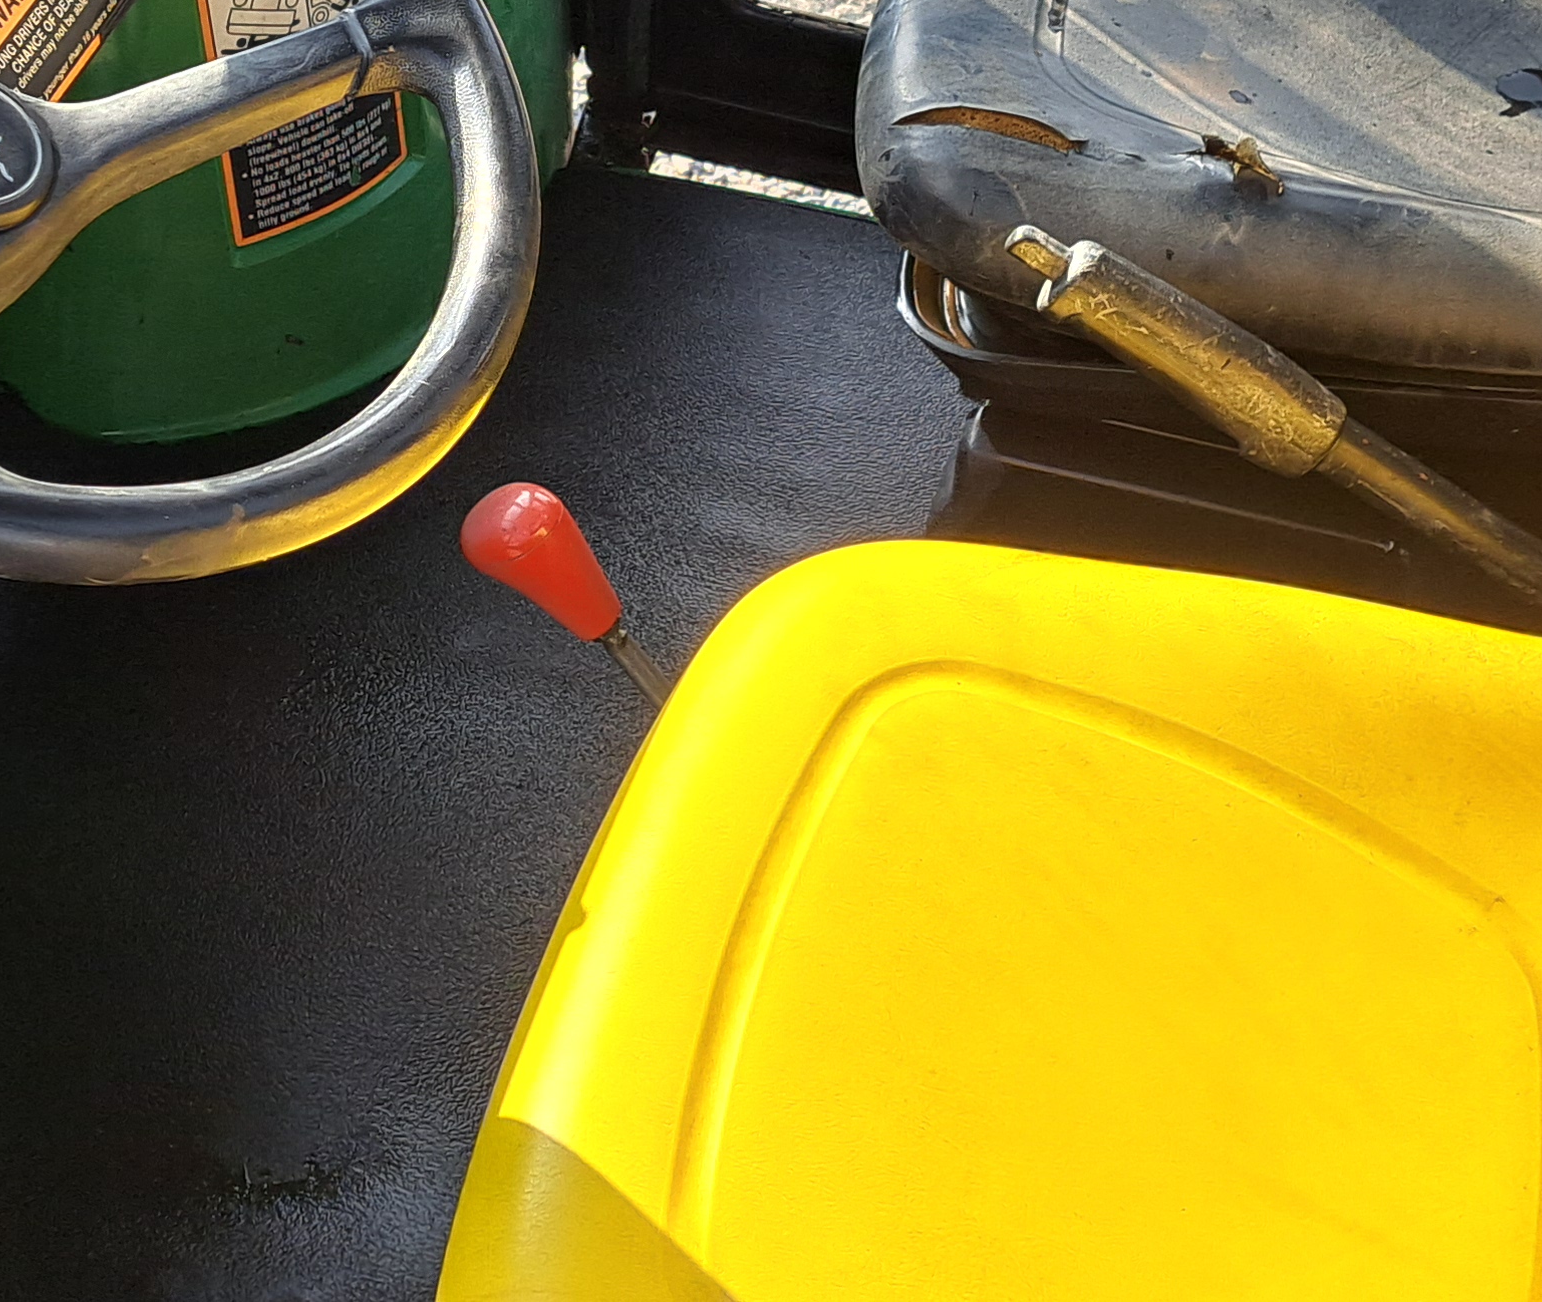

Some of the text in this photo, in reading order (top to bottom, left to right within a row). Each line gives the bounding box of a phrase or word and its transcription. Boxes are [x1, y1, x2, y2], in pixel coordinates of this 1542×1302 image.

[13, 1, 49, 46] DRIVERS
[12, 29, 46, 72] CHANCE
[43, 13, 55, 32] OF
[18, 58, 42, 88] drivers
[40, 39, 56, 60] may
[54, 23, 67, 41] not
[63, 14, 75, 27] be
[277, 127, 309, 144] Vehicle
[251, 167, 263, 176] No
[265, 158, 289, 171] loads
[291, 144, 321, 161] heavier
[323, 134, 340, 147] than
[285, 162, 301, 175] 800
[254, 183, 276, 197] 1000
[278, 178, 291, 188] lbs
[255, 190, 286, 208] Spread
[288, 181, 307, 195] load
[257, 201, 290, 218] Reduce
